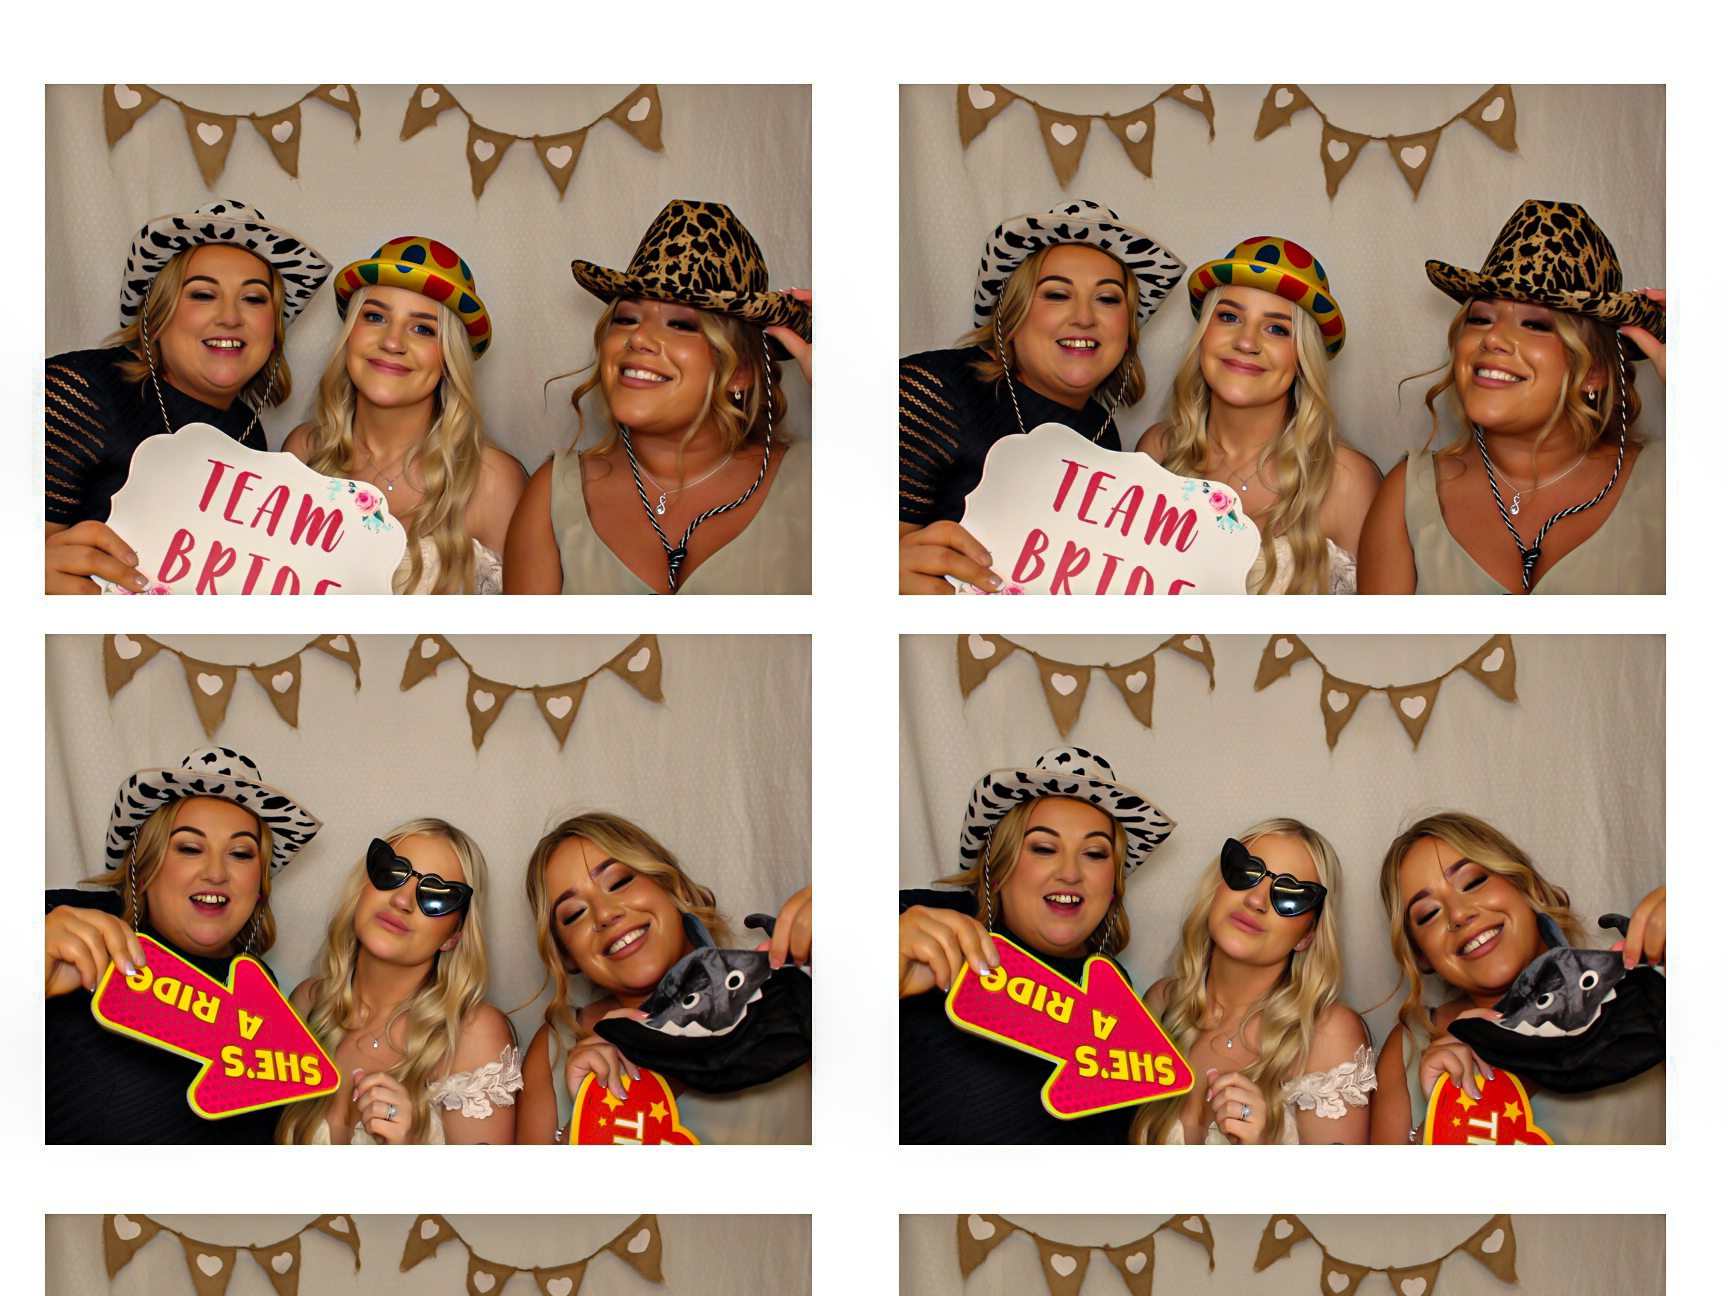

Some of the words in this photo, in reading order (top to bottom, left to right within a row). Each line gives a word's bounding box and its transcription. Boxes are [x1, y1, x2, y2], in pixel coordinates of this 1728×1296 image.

[199, 459, 344, 553] TEAM
[1053, 459, 1198, 553] TEAM
[157, 528, 342, 595] BRID
[1011, 528, 1196, 595] BRID
[237, 1009, 264, 1041] A
[1091, 1009, 1118, 1041] A
[221, 1045, 322, 1086] SHE'S
[1075, 1045, 1176, 1086] SHE'S
